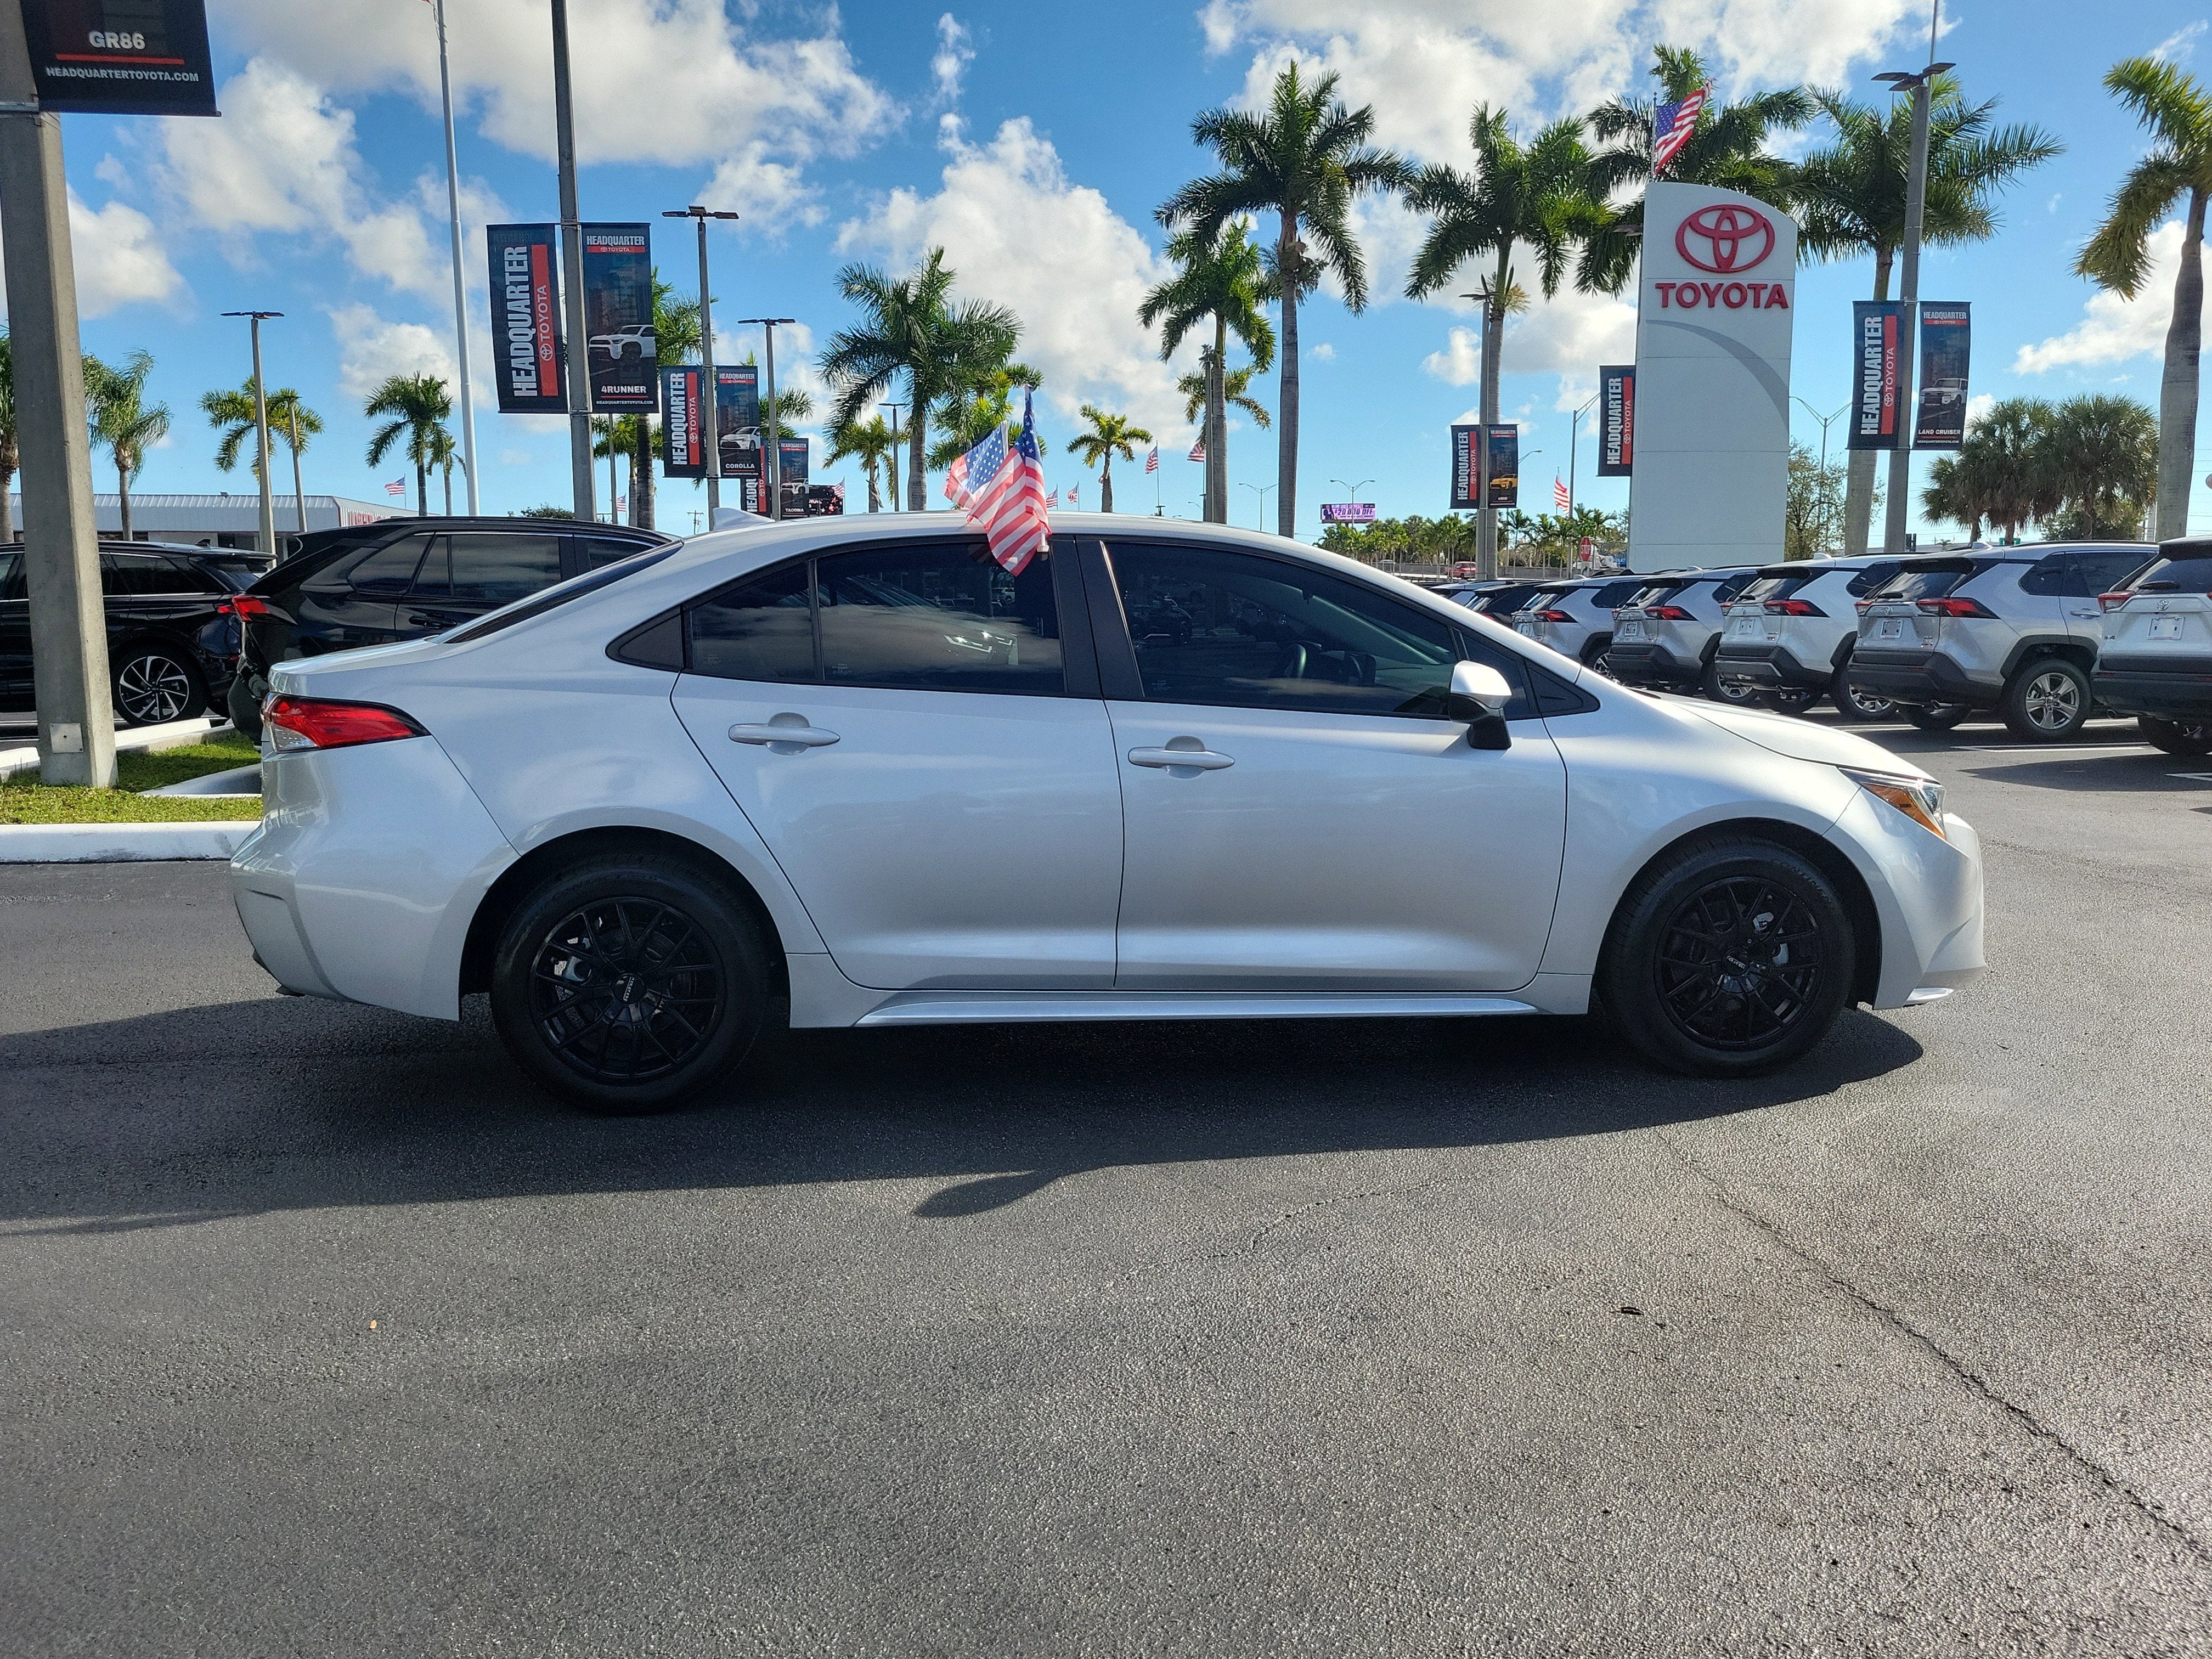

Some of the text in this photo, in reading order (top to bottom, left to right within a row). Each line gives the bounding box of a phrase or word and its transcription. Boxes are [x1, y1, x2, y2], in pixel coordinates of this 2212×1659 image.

[88, 30, 146, 50] GR86
[46, 67, 199, 82] HEADQUARTERTOYOTA.COM
[586, 235, 645, 246] HEADQUARTER
[1655, 281, 1790, 308] TOYOTA
[504, 246, 538, 396] HEADQUARTER
[537, 284, 550, 342] TOYOTA
[1923, 312, 1967, 320] HEADQUARTER
[1860, 317, 1883, 435] HEADQUARTER
[1884, 347, 1894, 392] TOYOTA
[601, 385, 647, 393] 4RUNNER
[669, 373, 688, 465] HEADQUARTER
[689, 397, 697, 432] TOYOTA
[1607, 377, 1623, 465] HEADQUARTER
[1457, 432, 1470, 500] HEADQUARTER
[1581, 545, 1590, 554] STOP
